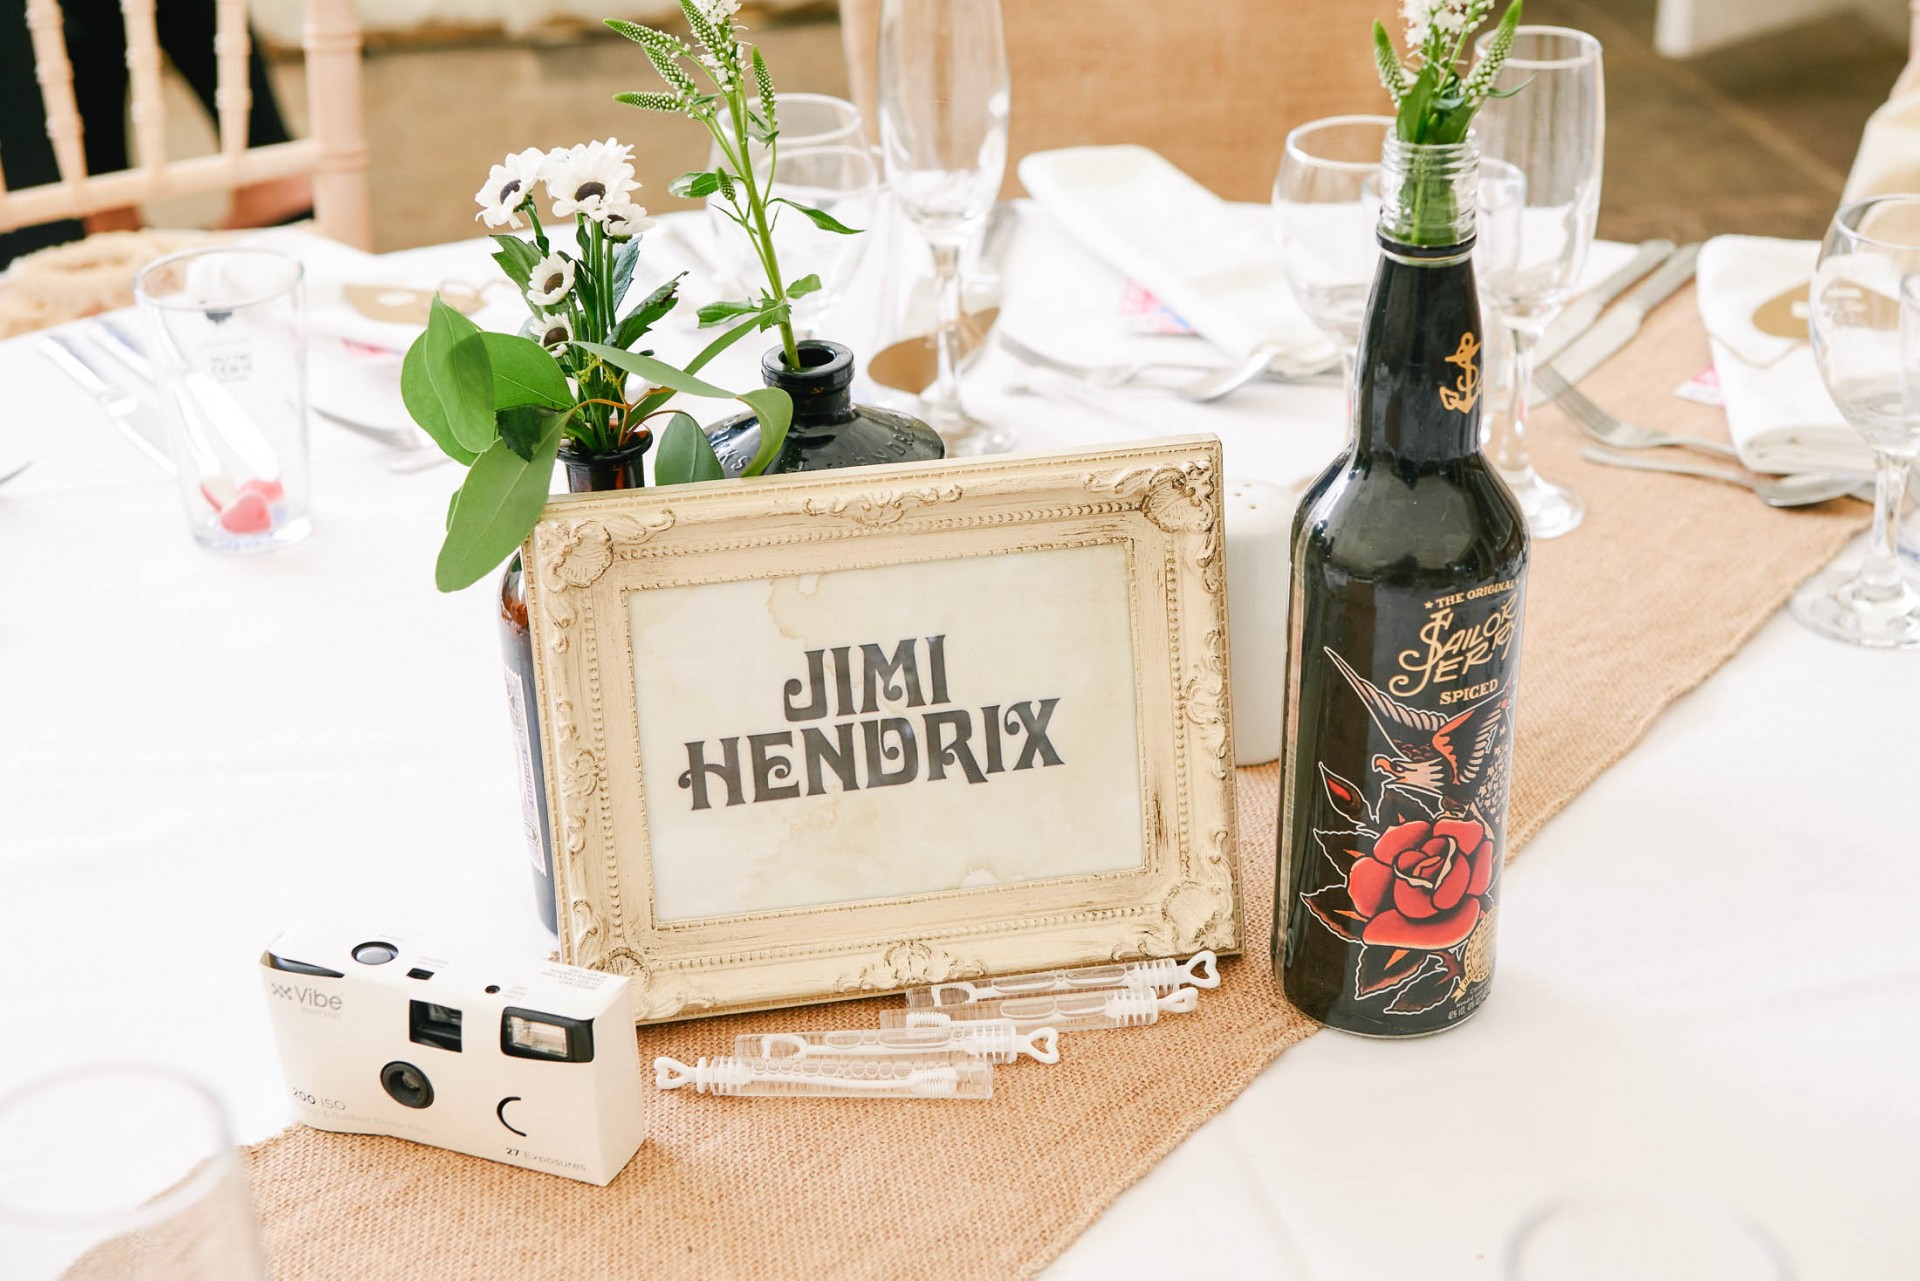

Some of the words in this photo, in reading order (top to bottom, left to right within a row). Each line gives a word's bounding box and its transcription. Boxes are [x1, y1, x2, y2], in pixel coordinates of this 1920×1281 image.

[1435, 592, 1464, 609] THE
[1466, 579, 1516, 600] ORIGINAL
[1398, 592, 1518, 671] SAILOR
[1388, 608, 1518, 697] JERRY
[783, 634, 951, 722] JIMI
[1439, 678, 1499, 705] SPICED
[677, 697, 1066, 811] HENDRIX
[294, 985, 343, 1011] Vibe
[292, 1086, 316, 1105] 200
[320, 1097, 346, 1111] ISO
[504, 1146, 520, 1157] 27
[523, 1151, 587, 1172] Exposures
